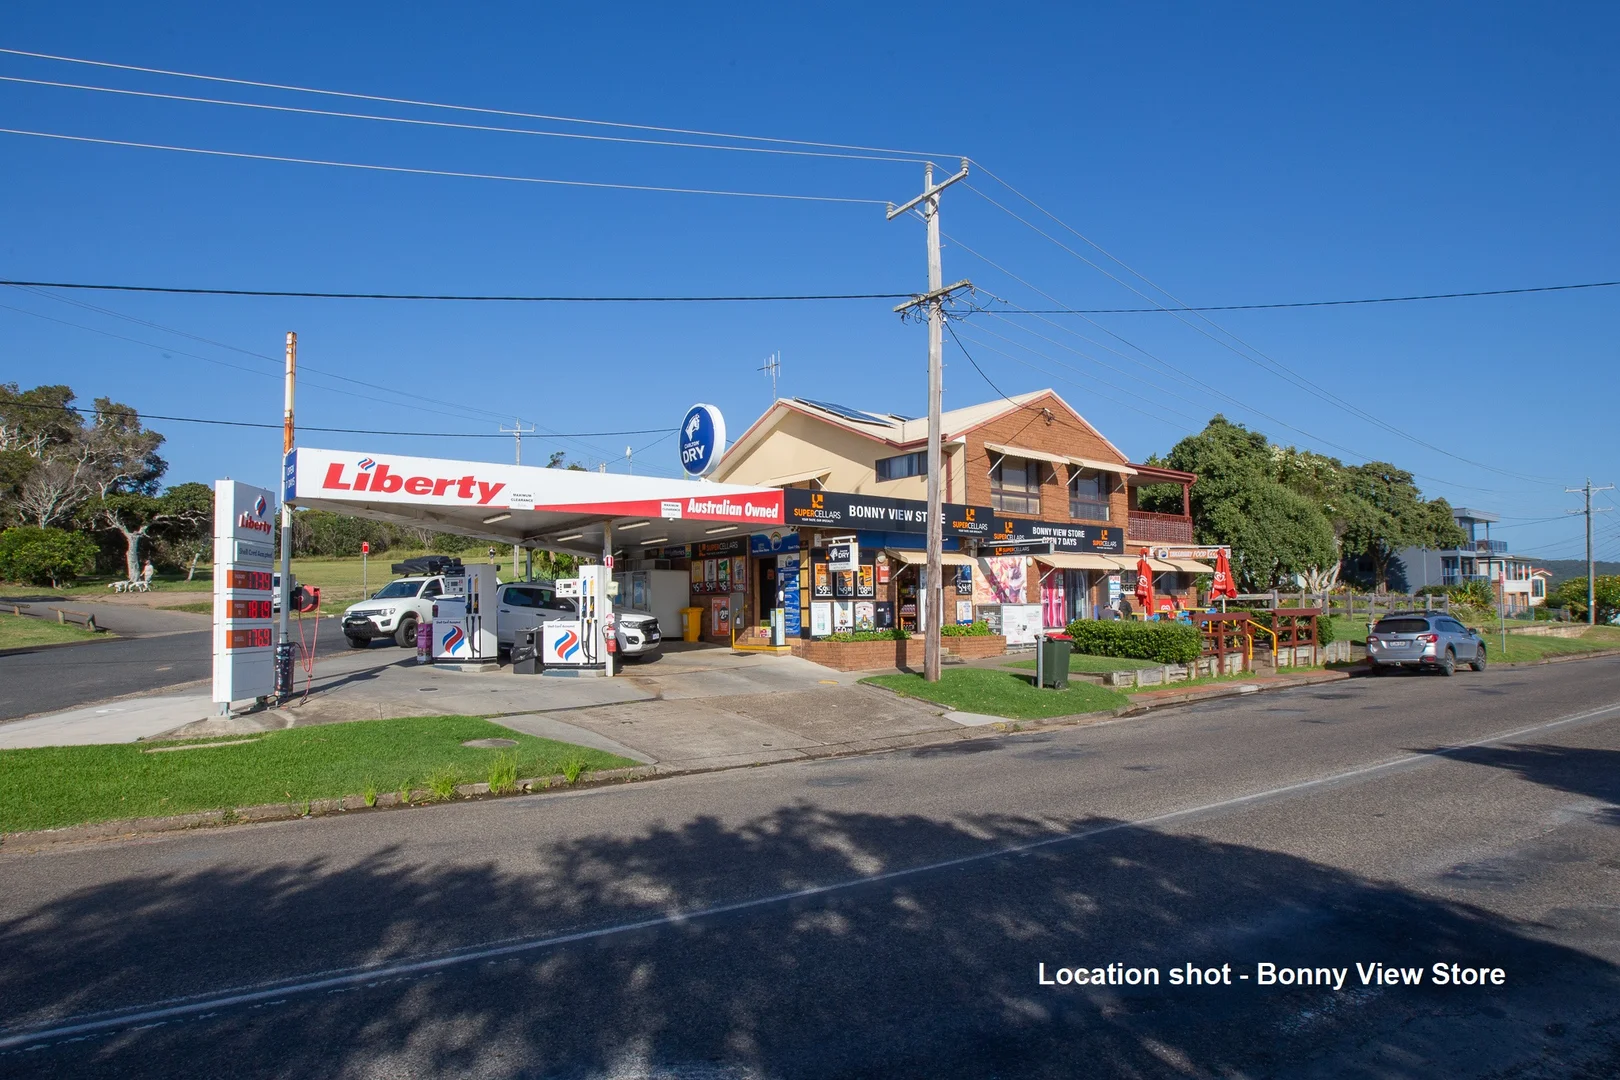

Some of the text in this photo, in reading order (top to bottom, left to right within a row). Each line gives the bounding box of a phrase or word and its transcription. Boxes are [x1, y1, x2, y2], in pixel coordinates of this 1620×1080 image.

[683, 445, 705, 464] DRY
[322, 462, 506, 504] Liberty
[688, 498, 778, 518] Australian Owned
[794, 508, 841, 520] SUPERCELLARS
[849, 505, 946, 524] BONNY VIEW STE
[239, 512, 272, 535] Liberty
[952, 521, 988, 530] SUPERCELLARS
[1032, 526, 1085, 538] BONNY VIEW STORE
[1062, 538, 1077, 546] DAYS
